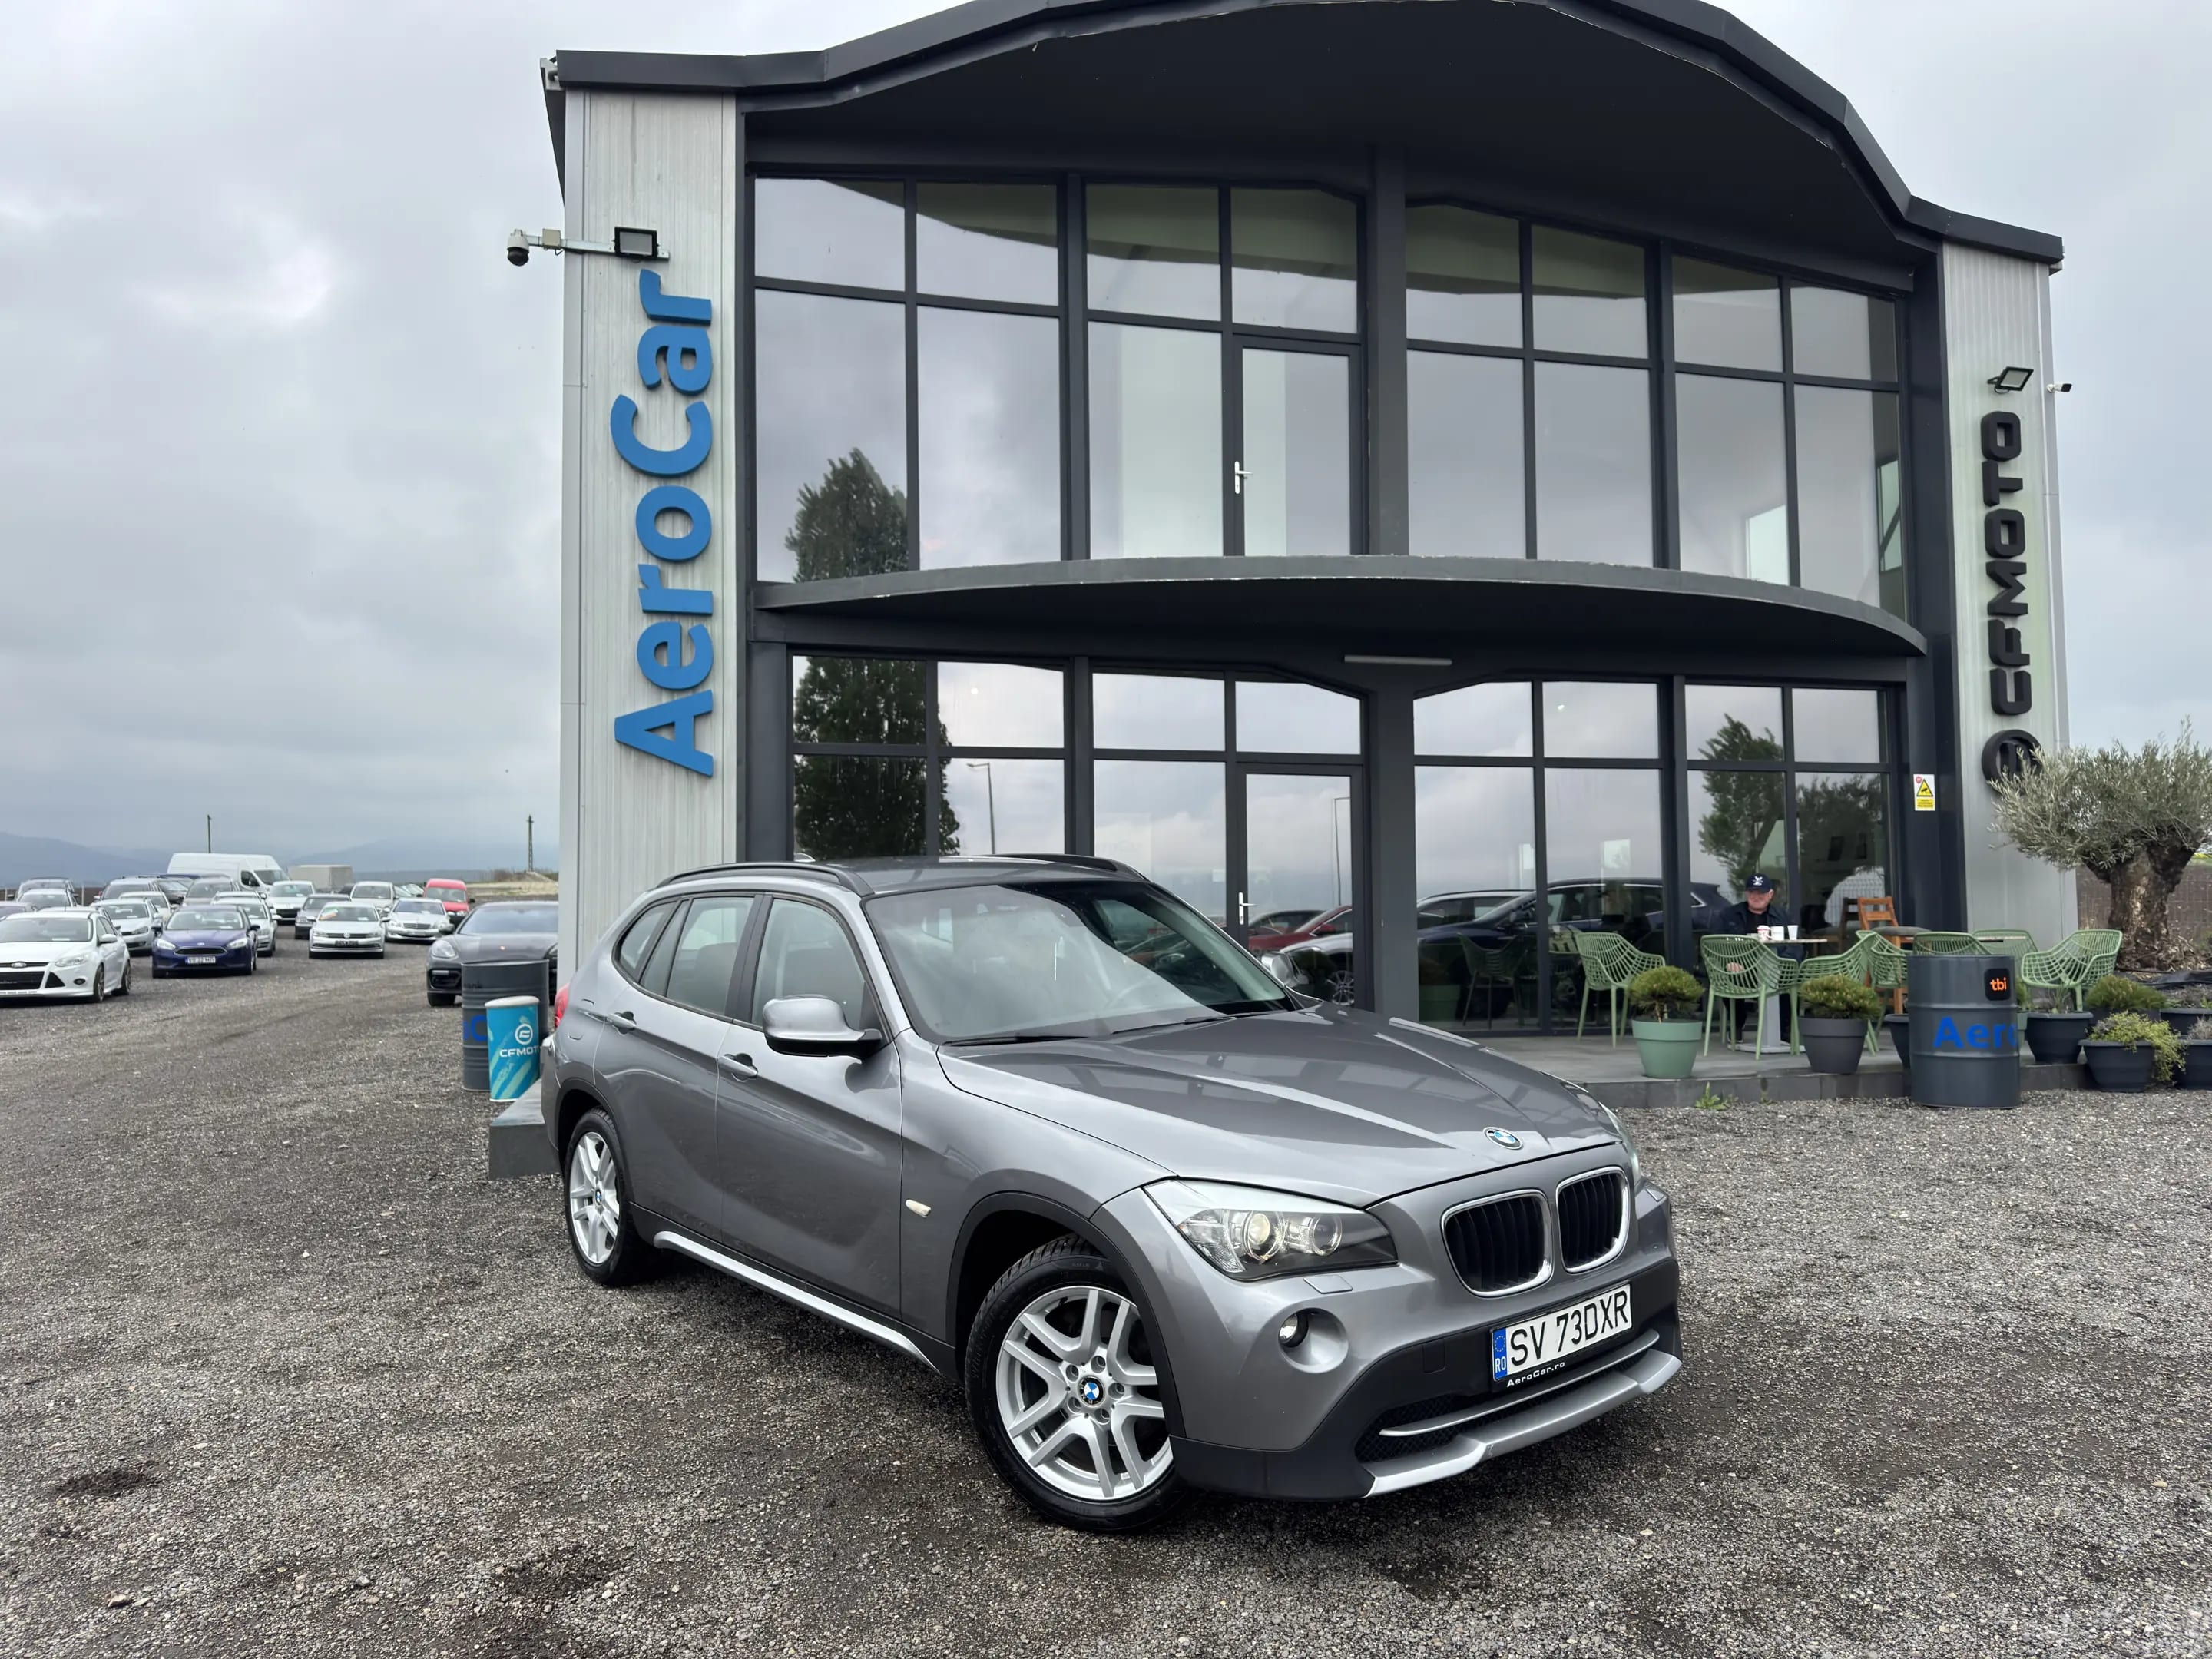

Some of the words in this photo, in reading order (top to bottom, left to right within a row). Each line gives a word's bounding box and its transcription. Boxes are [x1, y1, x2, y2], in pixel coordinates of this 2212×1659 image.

[611, 269, 713, 777] AeroCar
[1981, 411, 2032, 716] CFMOTO
[1990, 977, 2007, 991] tbi
[1510, 1321, 1546, 1366] SV
[1495, 1356, 1507, 1373] RO
[1506, 1361, 1565, 1388] AeroCar.ro
